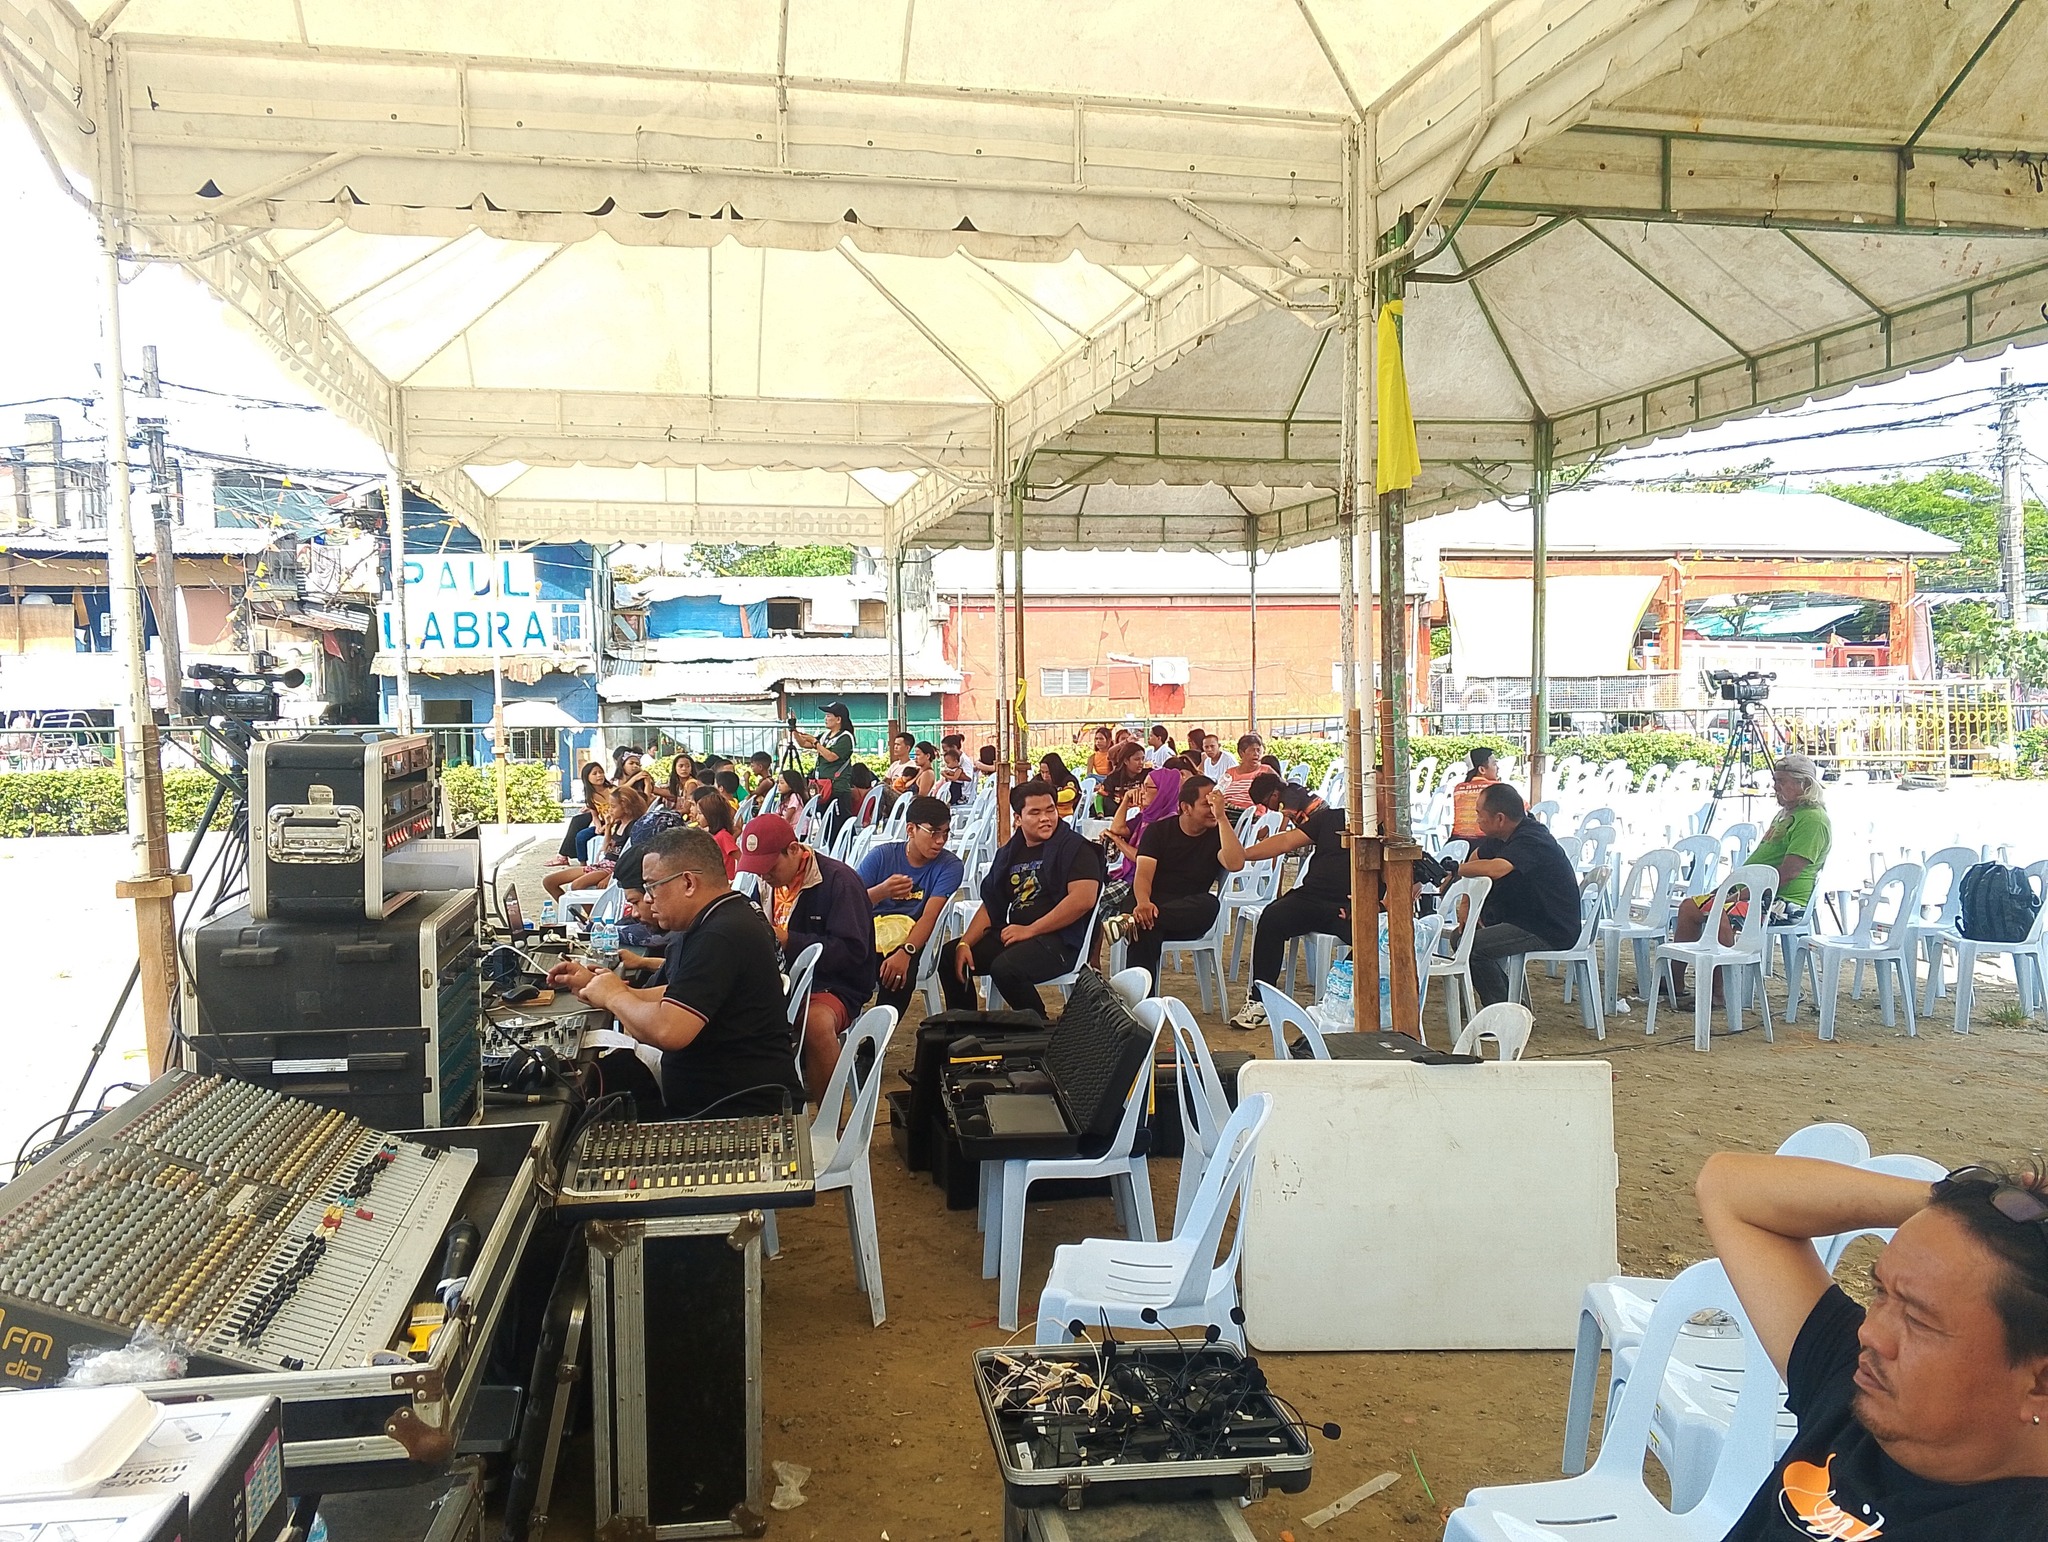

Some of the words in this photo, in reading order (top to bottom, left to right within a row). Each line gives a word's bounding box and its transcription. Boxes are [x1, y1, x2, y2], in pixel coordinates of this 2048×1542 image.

[401, 560, 530, 597] PAUL
[383, 610, 547, 650] LABRA
[2, 1326, 54, 1360] FM
